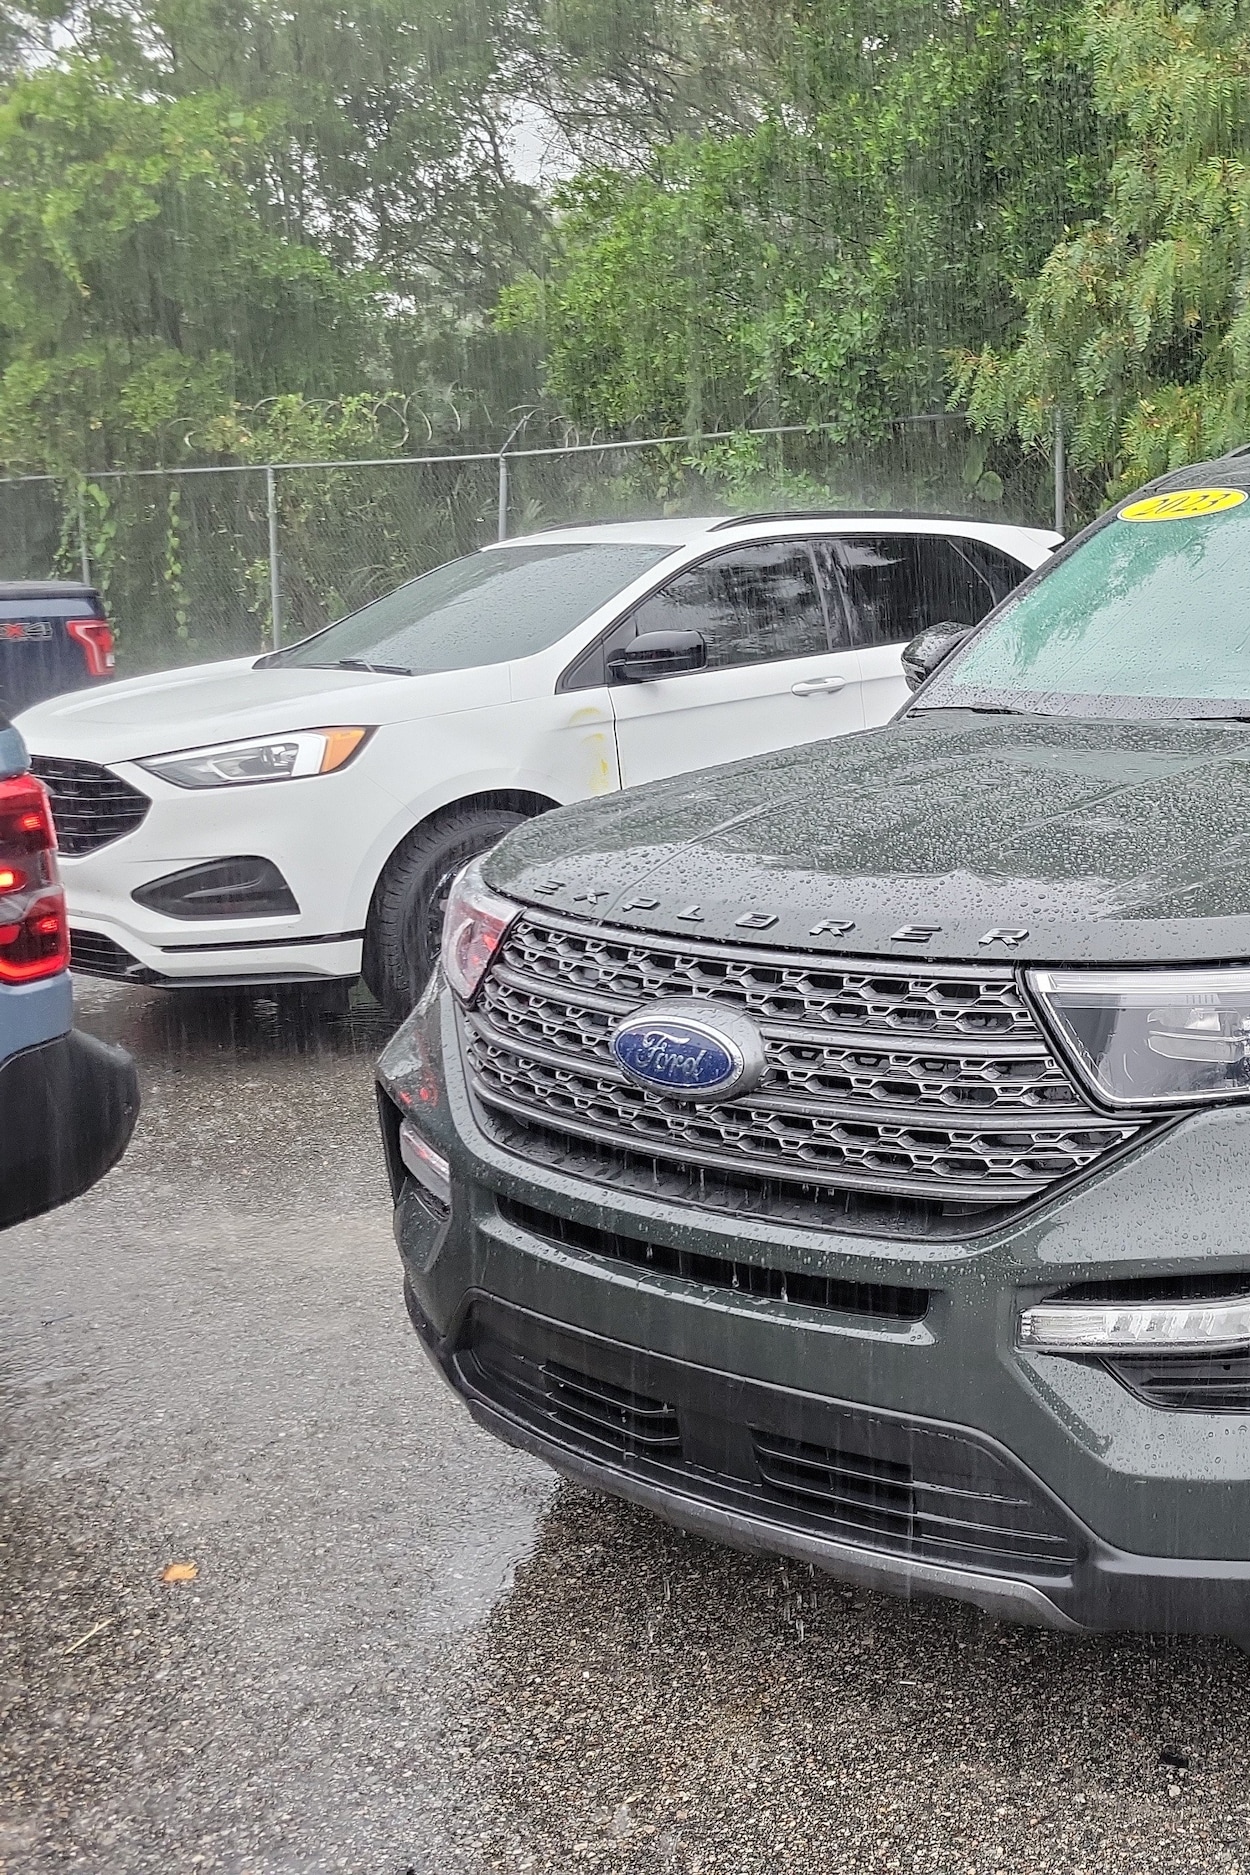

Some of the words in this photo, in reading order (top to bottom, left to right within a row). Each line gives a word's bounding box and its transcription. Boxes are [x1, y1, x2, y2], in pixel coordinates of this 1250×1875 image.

[1131, 492, 1232, 517] 2023
[0, 621, 53, 641] X4
[532, 879, 1030, 947] EXPLORER
[635, 1030, 708, 1080] Ford
